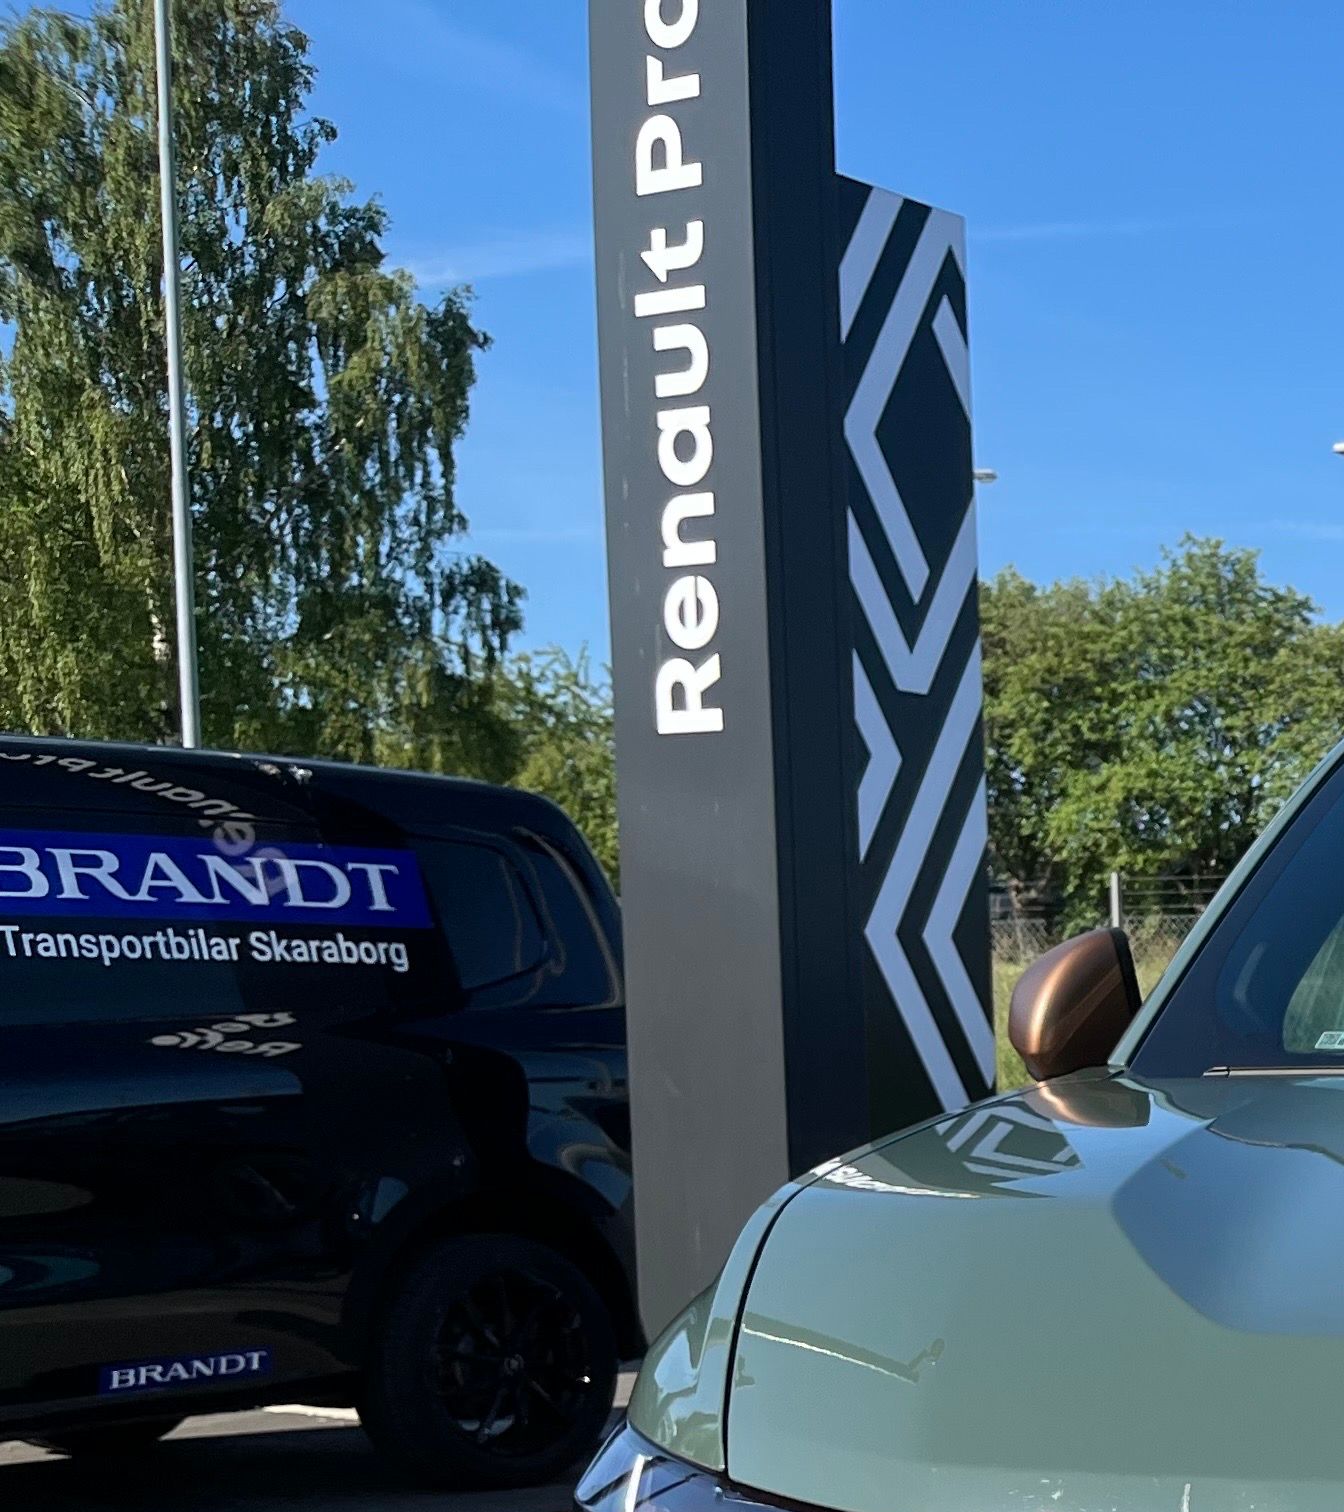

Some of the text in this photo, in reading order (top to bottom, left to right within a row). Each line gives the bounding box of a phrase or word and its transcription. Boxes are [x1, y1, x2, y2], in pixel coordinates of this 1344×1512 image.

[634, 219, 725, 736] Renault
[0, 846, 400, 912] BRANDT
[0, 924, 410, 972] Transportbilar Skaraborg
[109, 1350, 268, 1390] BRANDT
